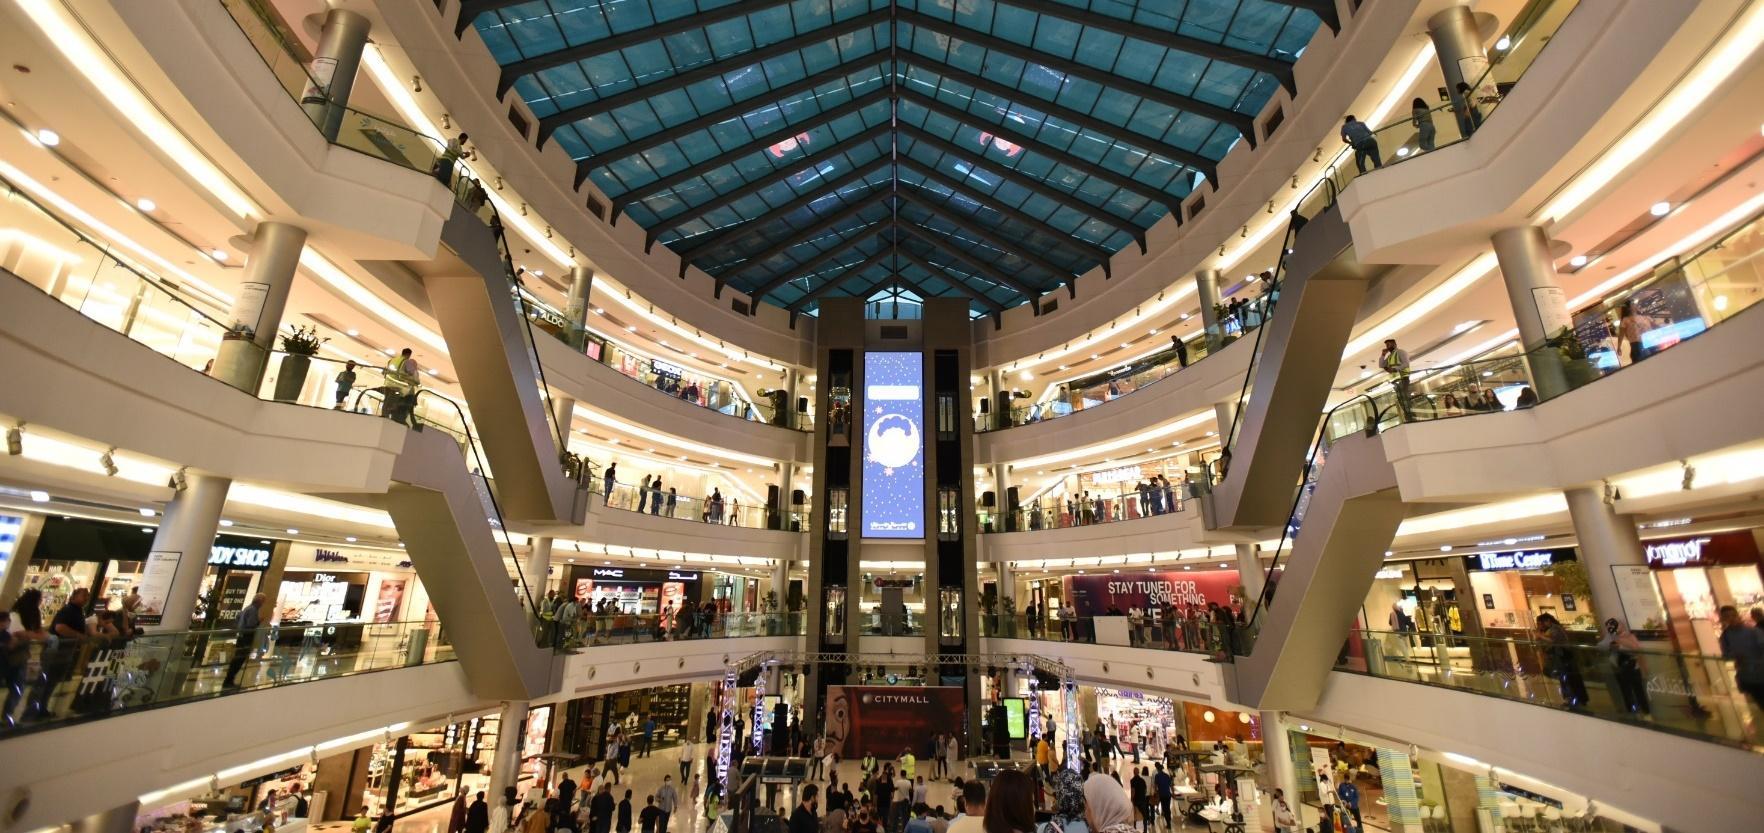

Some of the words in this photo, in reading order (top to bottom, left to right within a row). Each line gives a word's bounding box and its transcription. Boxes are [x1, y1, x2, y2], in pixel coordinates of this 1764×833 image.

[541, 311, 564, 328] ALDO
[1514, 551, 1553, 568] Center
[315, 573, 336, 583] Dior
[594, 569, 623, 577] MAC
[1108, 581, 1134, 594] STAY
[1136, 581, 1172, 594] TUNED
[1174, 581, 1197, 594] FOR
[1150, 593, 1206, 605] SOMETHING
[875, 695, 929, 704] CITYMALL
